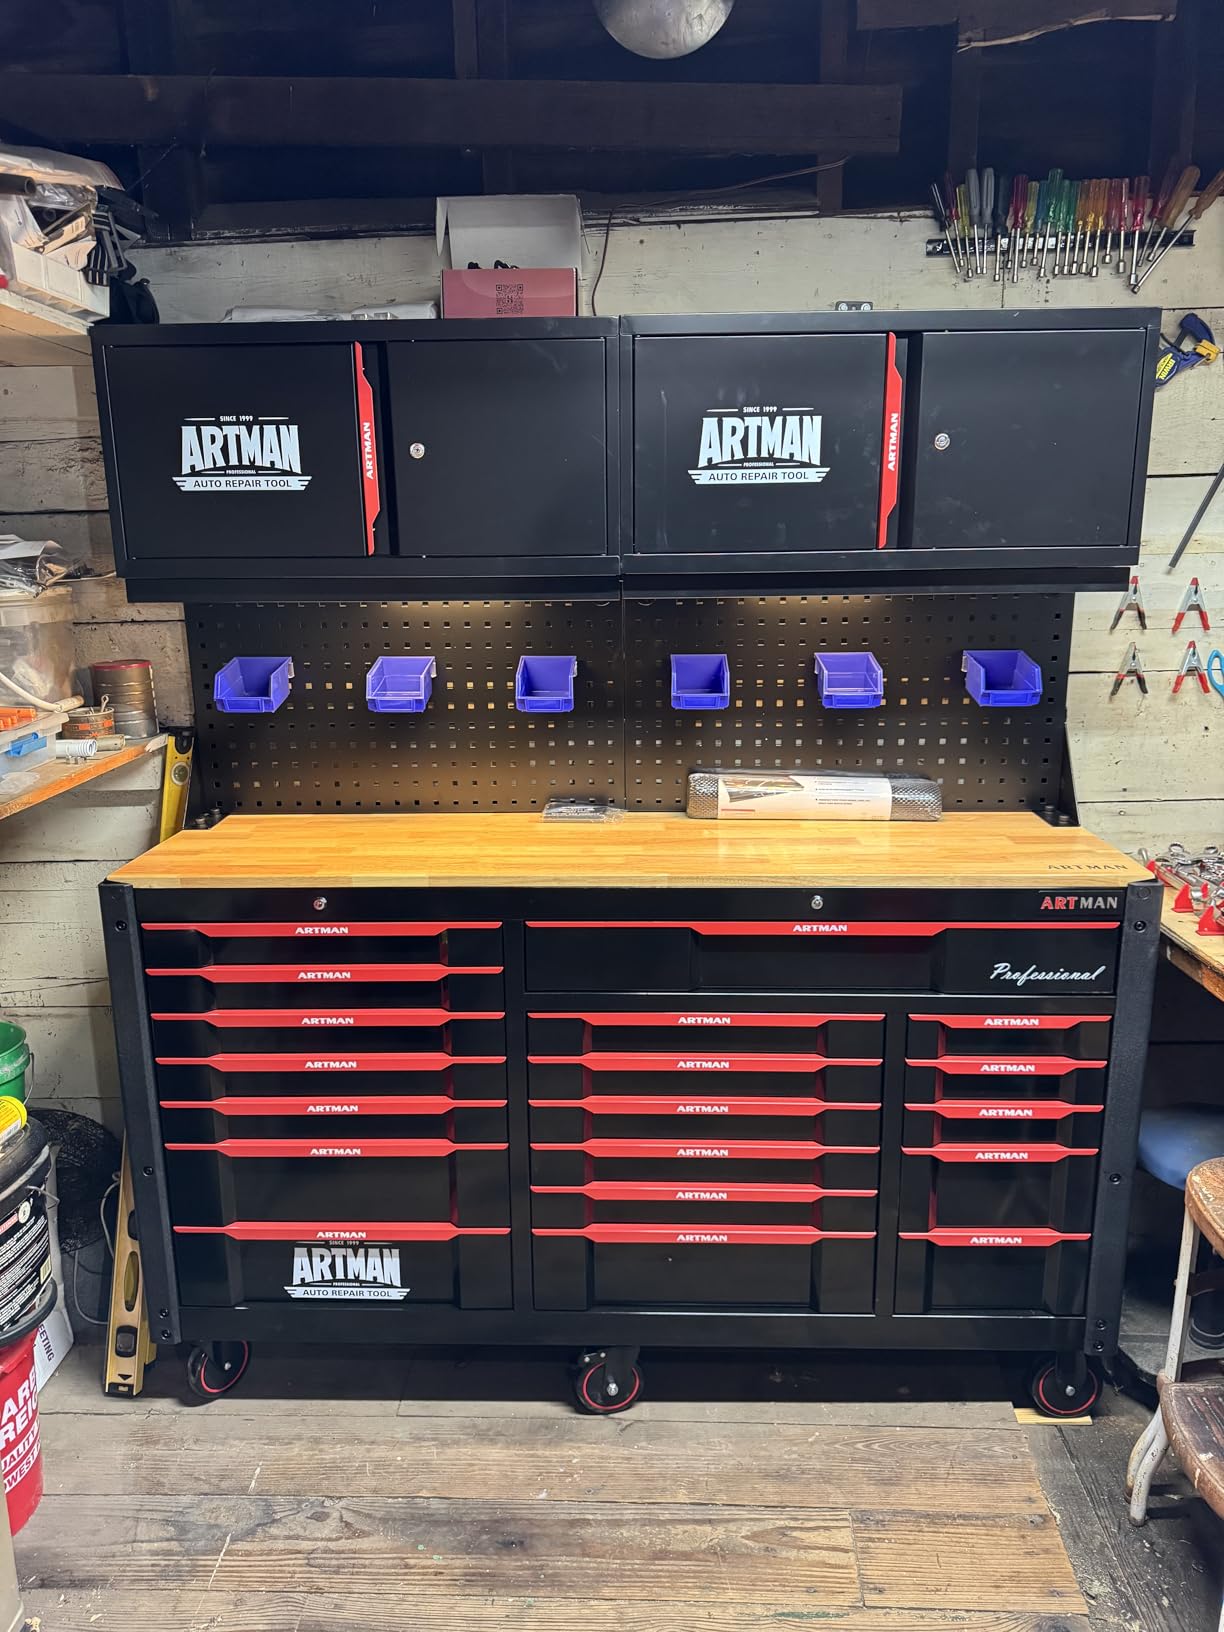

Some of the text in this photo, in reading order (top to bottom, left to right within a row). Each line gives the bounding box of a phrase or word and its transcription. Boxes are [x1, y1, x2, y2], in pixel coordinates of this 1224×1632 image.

[697, 415, 822, 468] ARTMAN
[888, 412, 899, 471] ARTMAN
[181, 424, 302, 475] ARTMAN
[363, 421, 374, 480] ARTMAN
[708, 471, 809, 481] AUTO REPAIR TOOL
[193, 479, 292, 488] AUTO REPAIR TOOL
[1040, 896, 1118, 910] ARTMAN
[295, 926, 349, 934] ARTMAN
[793, 924, 847, 933] ARTMAN
[298, 971, 351, 980] ARTMAN
[989, 962, 1106, 986] Professional
[301, 1017, 354, 1025] ARTMAN
[678, 1016, 731, 1025] ARTMAN
[984, 1018, 1040, 1026] ARTMAN
[304, 1061, 357, 1069] ARTMAN
[677, 1060, 730, 1069] ARTMAN
[980, 1064, 1036, 1072] ARTMAN
[307, 1105, 359, 1113] ARTMAN
[677, 1105, 729, 1113] ARTMAN
[979, 1108, 1033, 1117] ARTMAN
[311, 1148, 362, 1156] ARTMAN
[676, 1149, 729, 1157] ARTMAN
[975, 1152, 1029, 1160] ARTMAN
[676, 1191, 728, 1199] ARTMAN
[316, 1231, 367, 1239] ARTMAN
[676, 1234, 728, 1242] ARTMAN
[970, 1236, 1023, 1244] ARTMAN
[292, 1247, 402, 1287] ARTMAN
[331, 1289, 365, 1297] REPAIR
